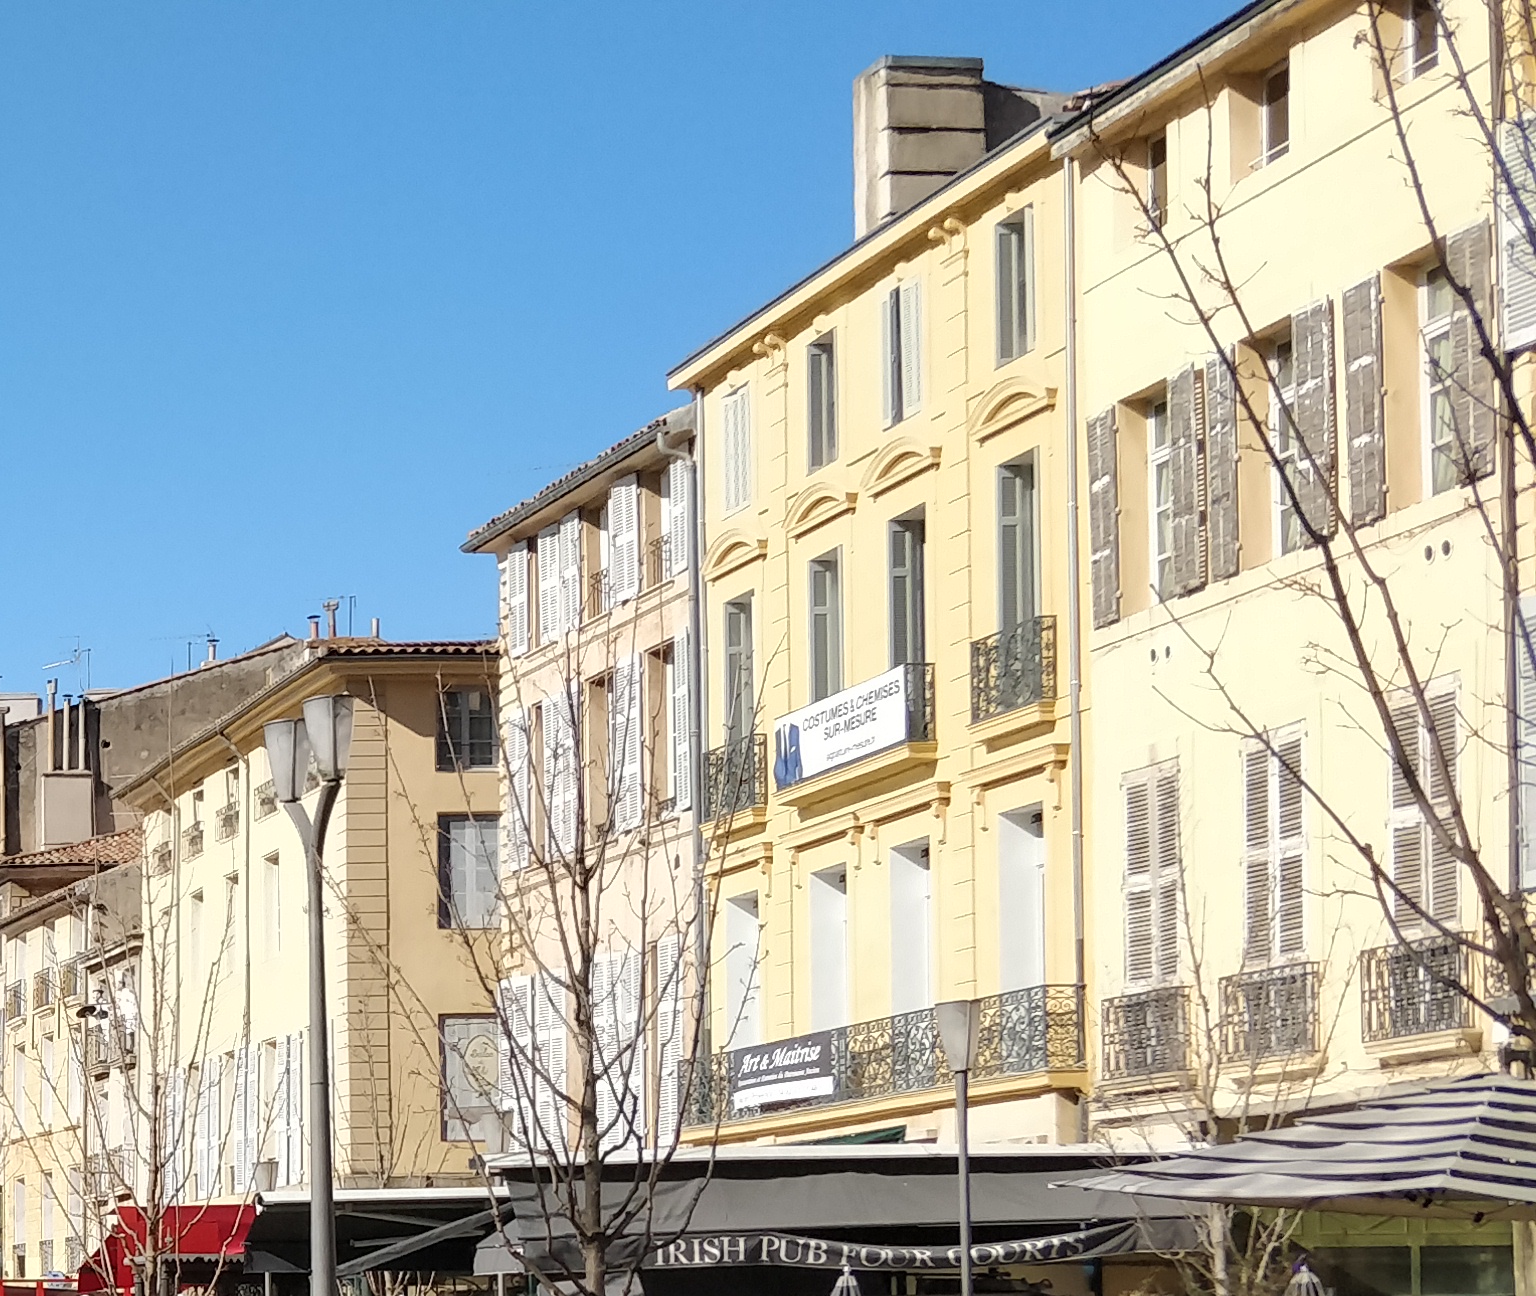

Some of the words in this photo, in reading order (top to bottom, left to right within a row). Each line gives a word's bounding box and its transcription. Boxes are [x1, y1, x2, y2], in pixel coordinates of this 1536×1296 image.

[803, 701, 849, 731] COSTUMES
[856, 679, 900, 710] CHEMISES
[824, 707, 877, 740] SUR-MESURE
[738, 1053, 761, 1077] Art
[759, 1054, 769, 1070] &
[654, 1236, 747, 1266] IRISH
[759, 1235, 827, 1265] PUB
[839, 1245, 935, 1267] FOUR
[946, 1233, 1084, 1266] COURTS
